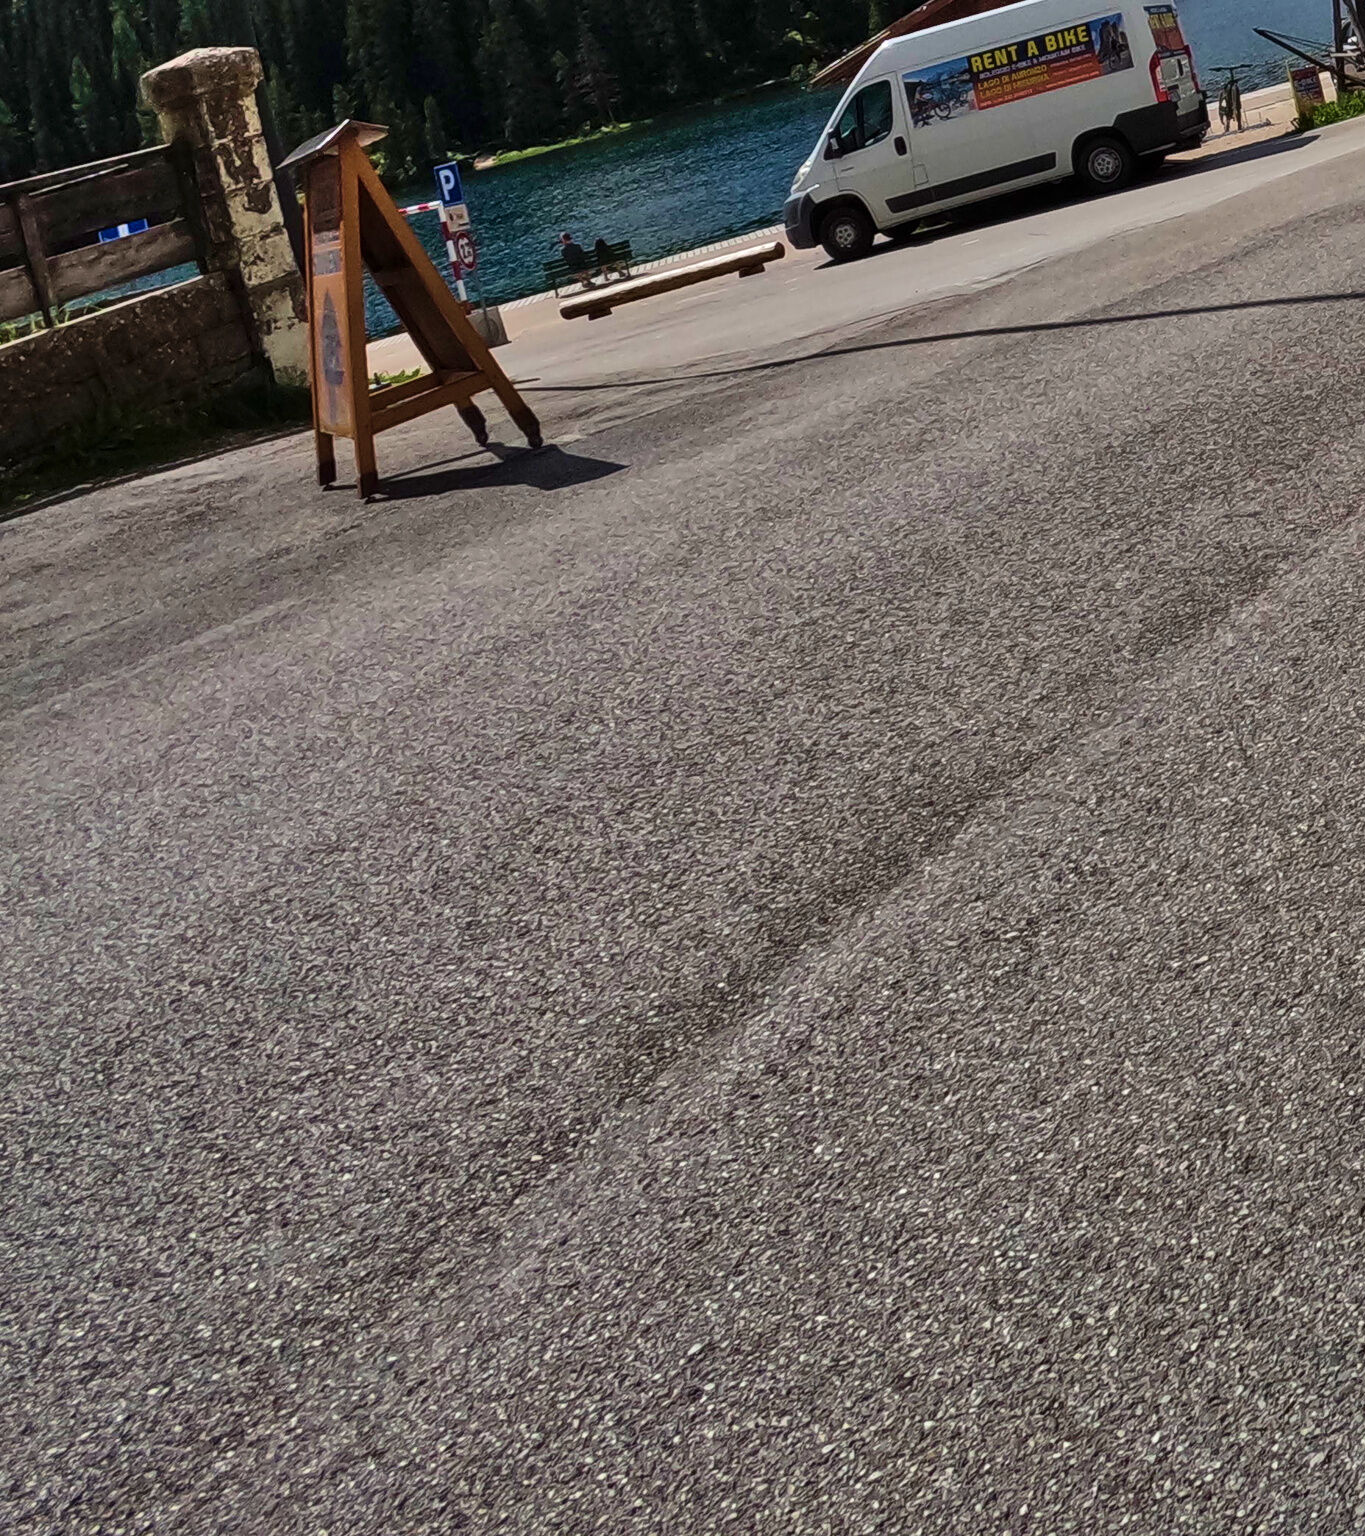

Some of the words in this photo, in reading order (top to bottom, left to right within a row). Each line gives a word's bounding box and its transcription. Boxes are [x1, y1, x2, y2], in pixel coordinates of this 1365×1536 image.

[970, 45, 1018, 73] RENT
[1026, 40, 1039, 57] A
[1044, 25, 1089, 52] BIKE
[977, 77, 1000, 91] LAGO
[439, 168, 455, 201] P
